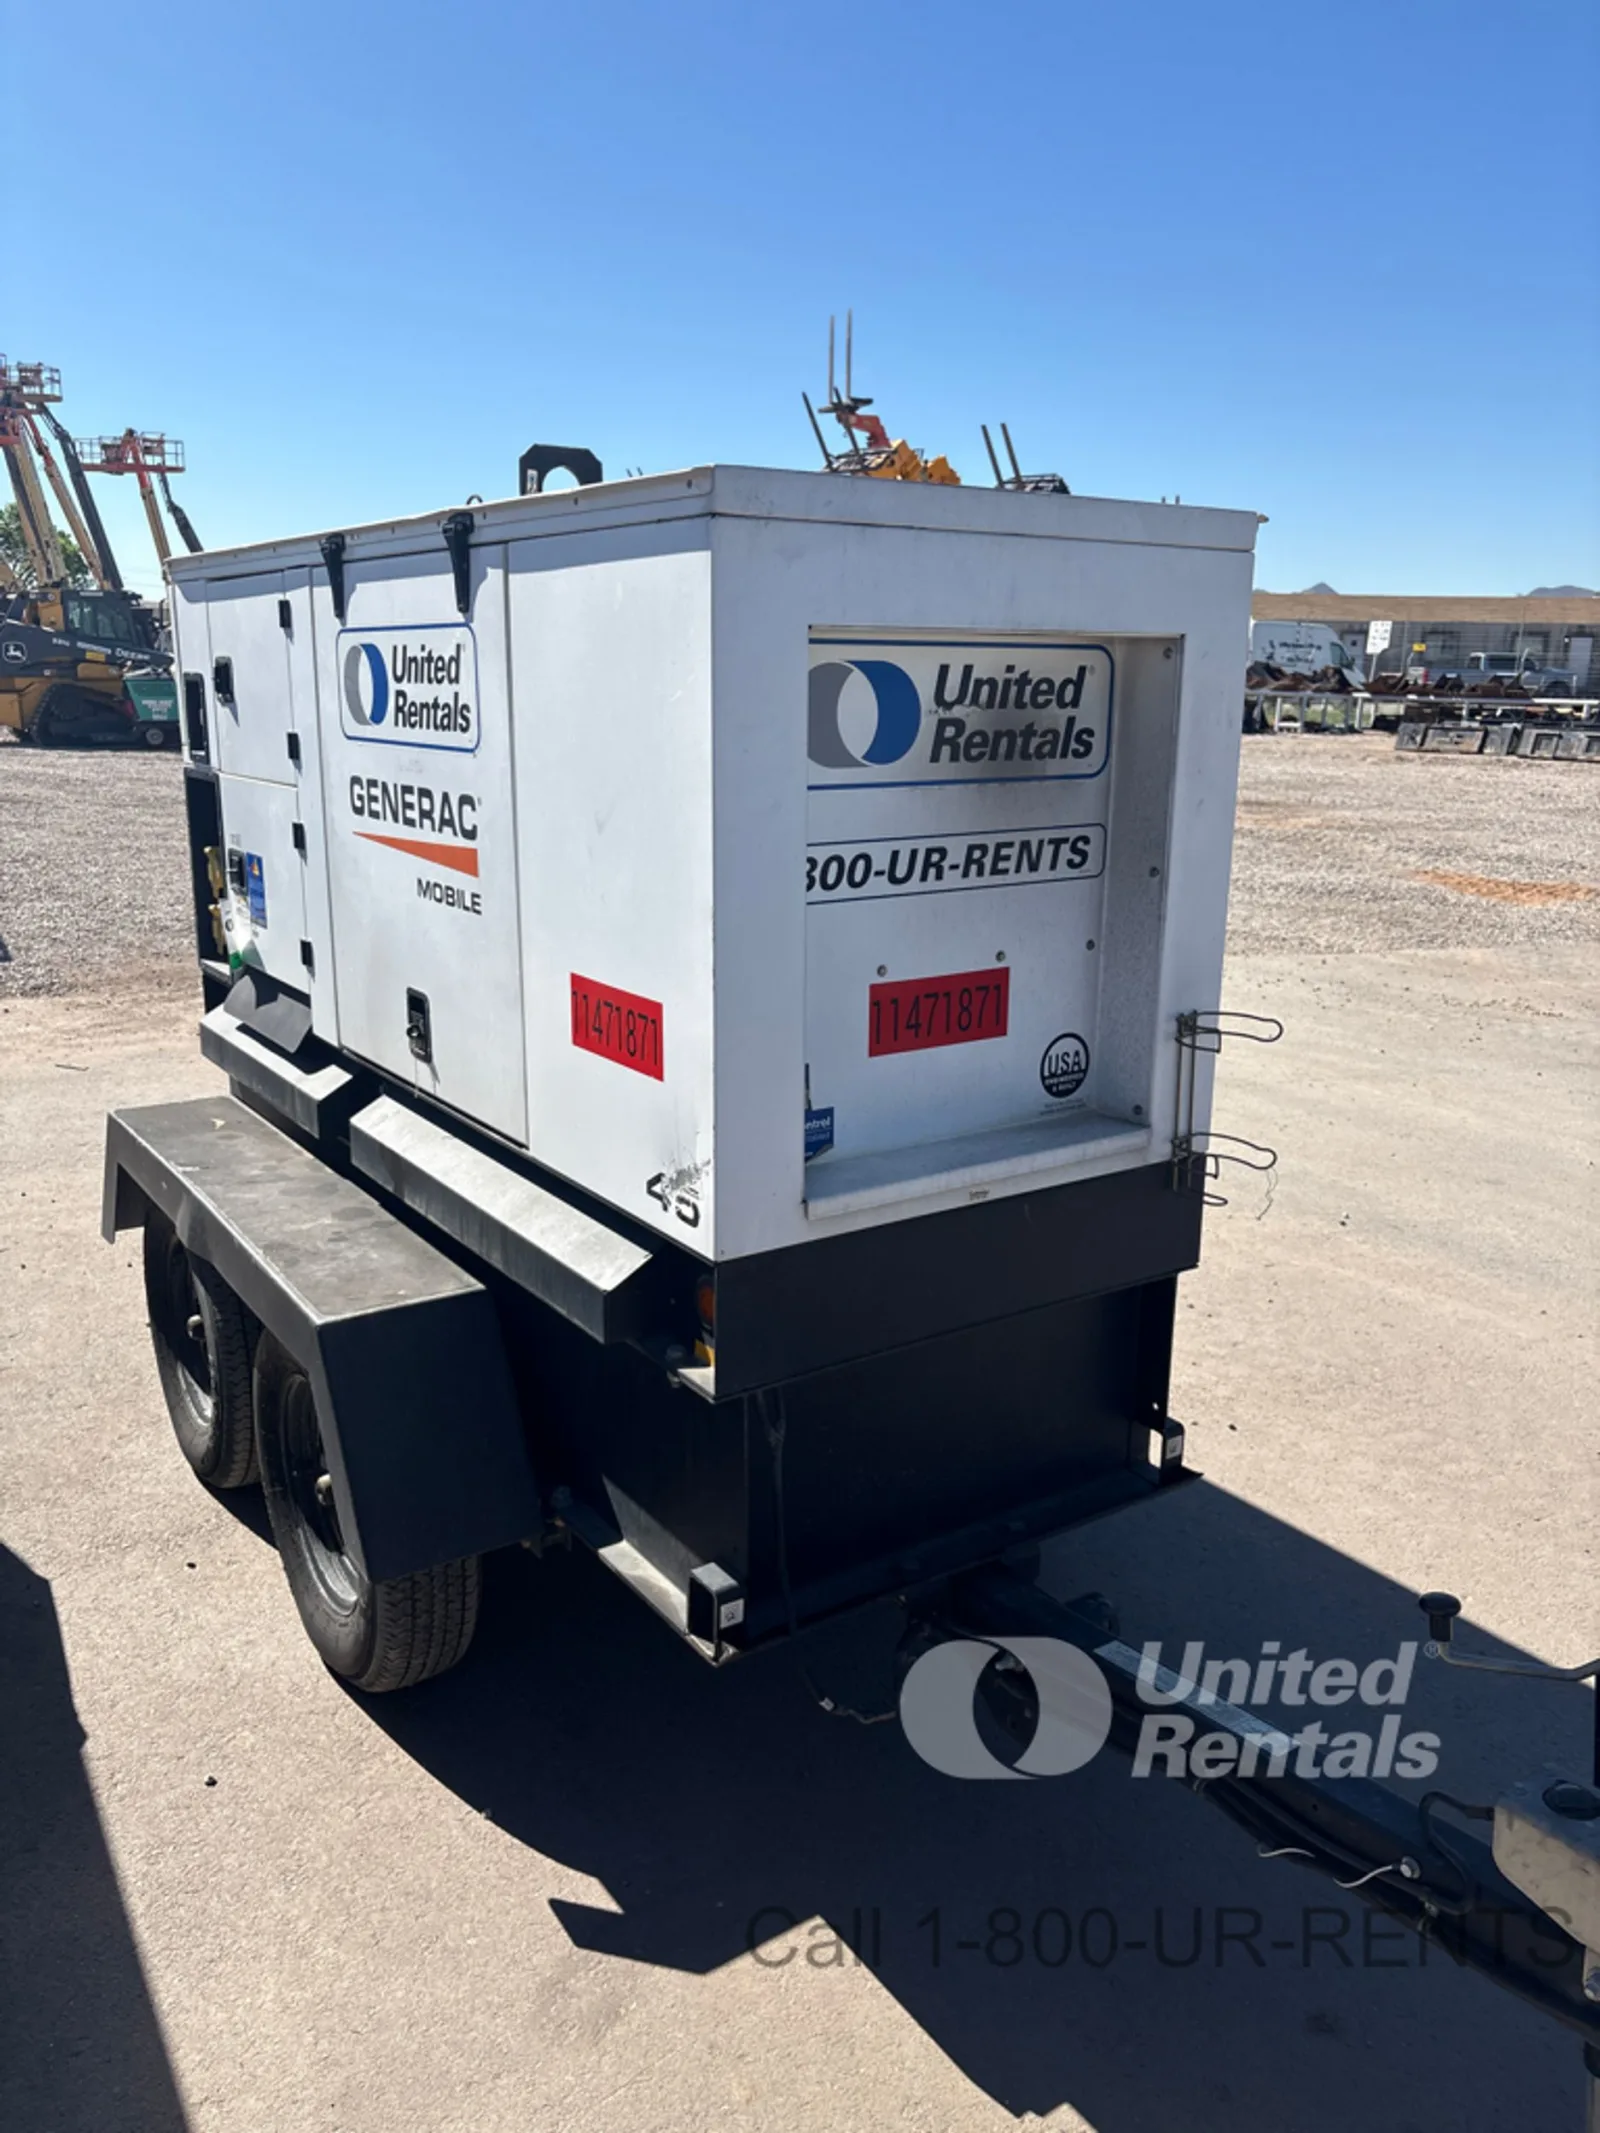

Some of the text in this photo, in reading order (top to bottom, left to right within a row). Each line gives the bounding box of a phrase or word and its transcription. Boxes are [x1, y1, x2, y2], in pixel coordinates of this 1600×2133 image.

[392, 643, 462, 685] United
[933, 663, 1087, 711] United
[394, 689, 472, 734] Rentals
[929, 716, 1096, 764] Rentals
[349, 774, 478, 842] GENERAC
[416, 877, 483, 916] MOBILE
[571, 989, 659, 1067] 11471871
[872, 983, 1002, 1045] 11471871
[1047, 1049, 1082, 1077] USA
